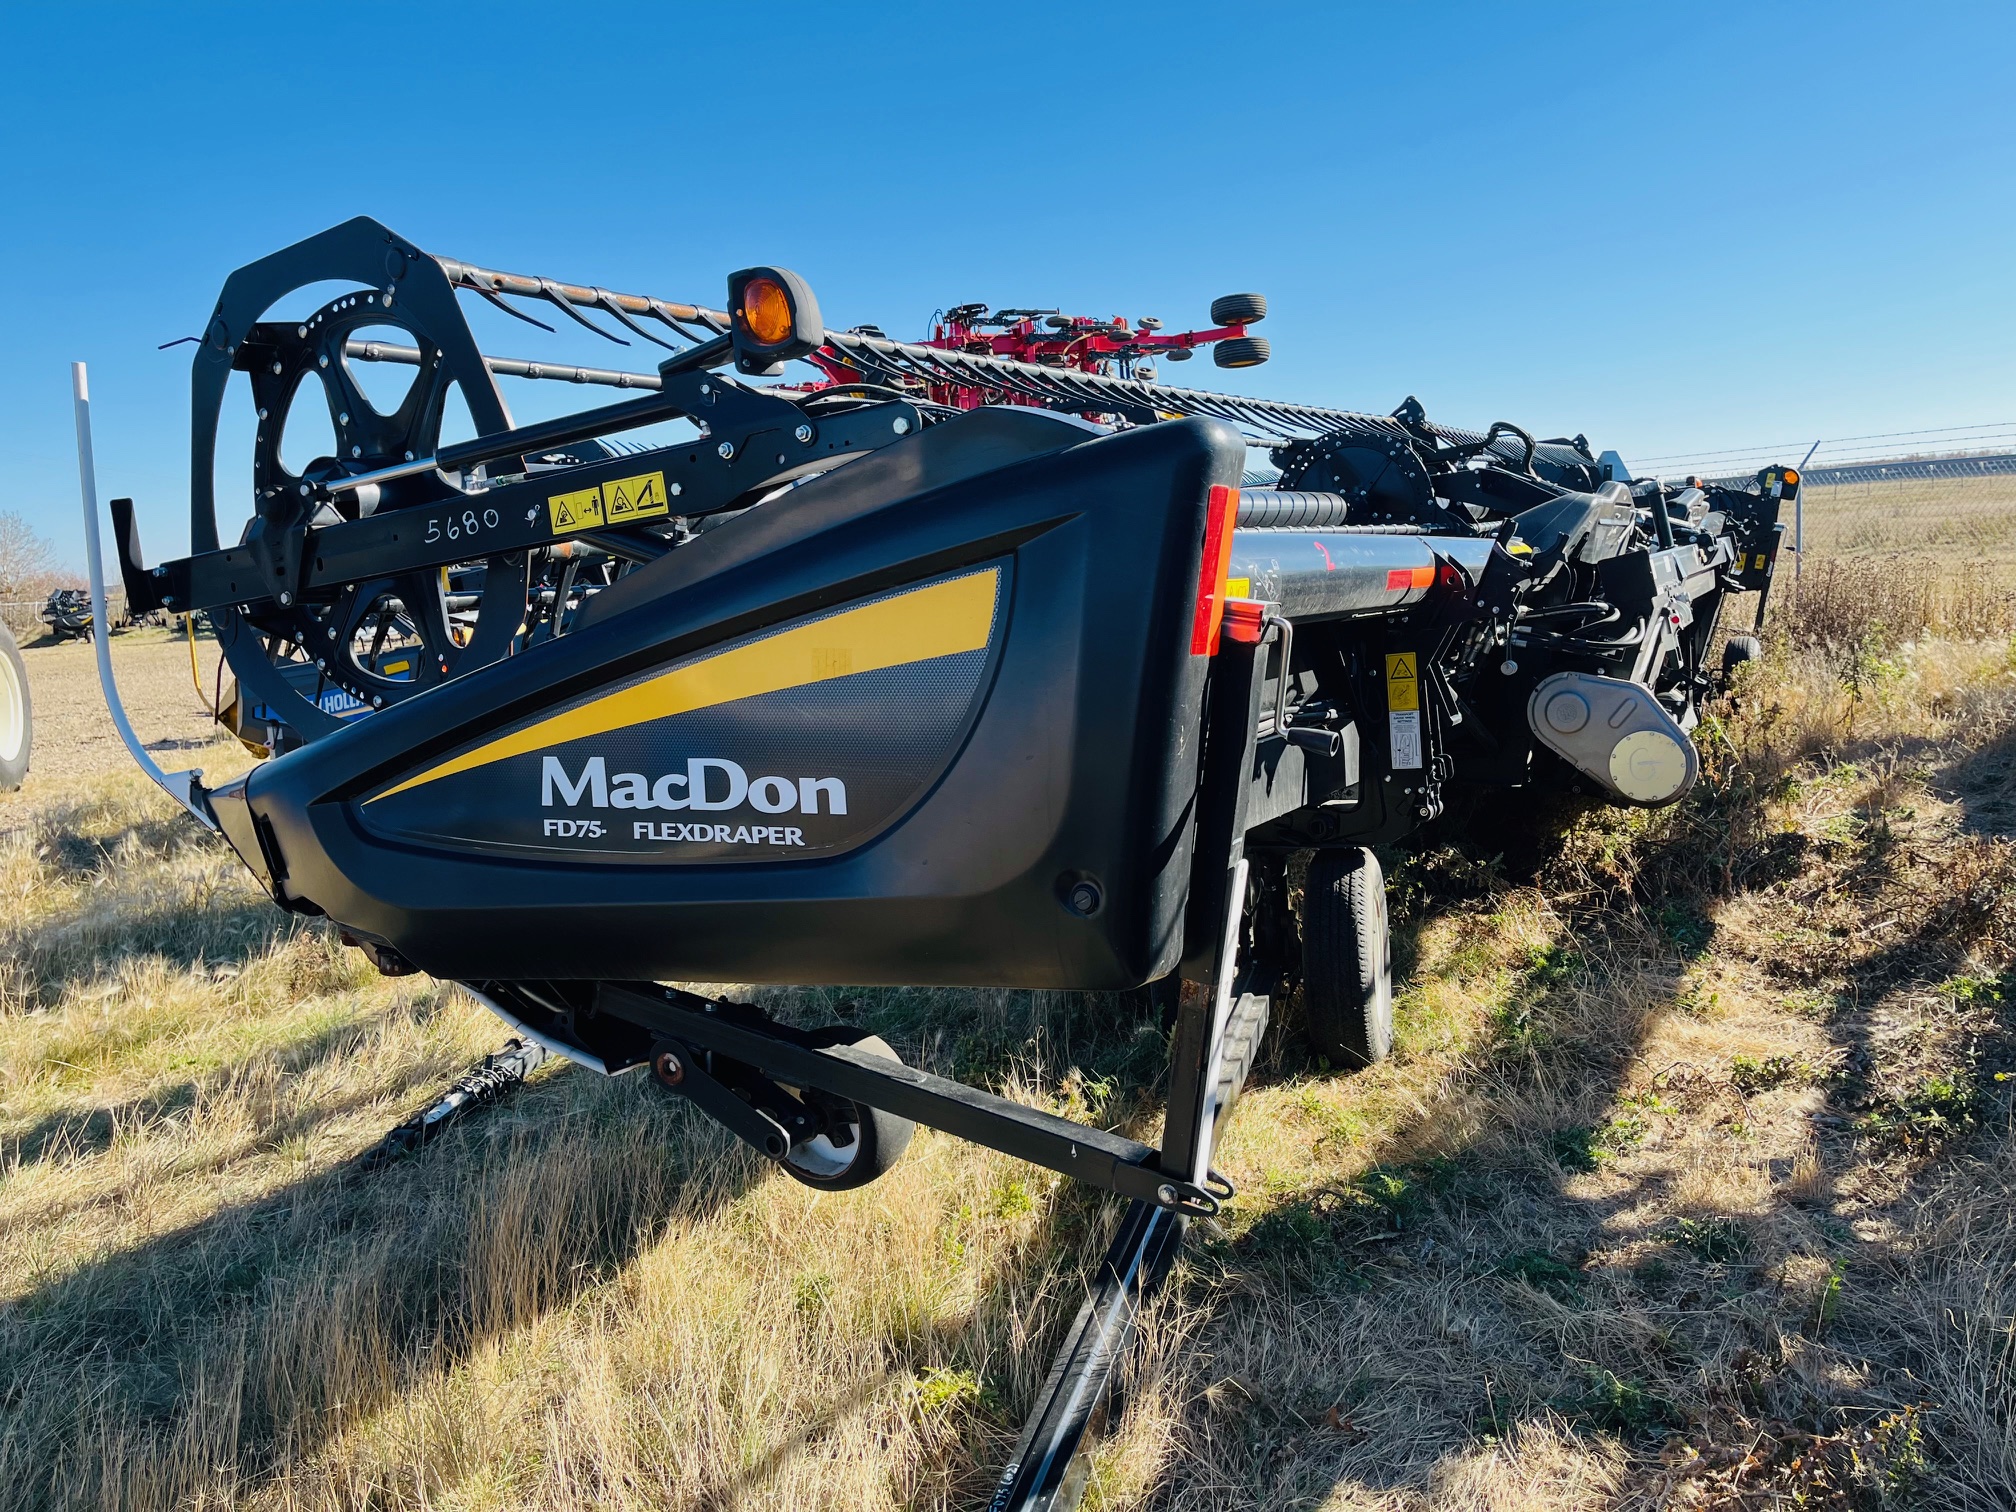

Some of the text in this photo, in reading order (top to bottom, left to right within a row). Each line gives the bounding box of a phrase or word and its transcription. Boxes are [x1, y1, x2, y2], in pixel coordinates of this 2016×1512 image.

[424, 508, 499, 544] 5680
[325, 692, 364, 714] HOLL
[541, 756, 848, 815] MacDon
[633, 821, 806, 846] FLEXDRAPER
